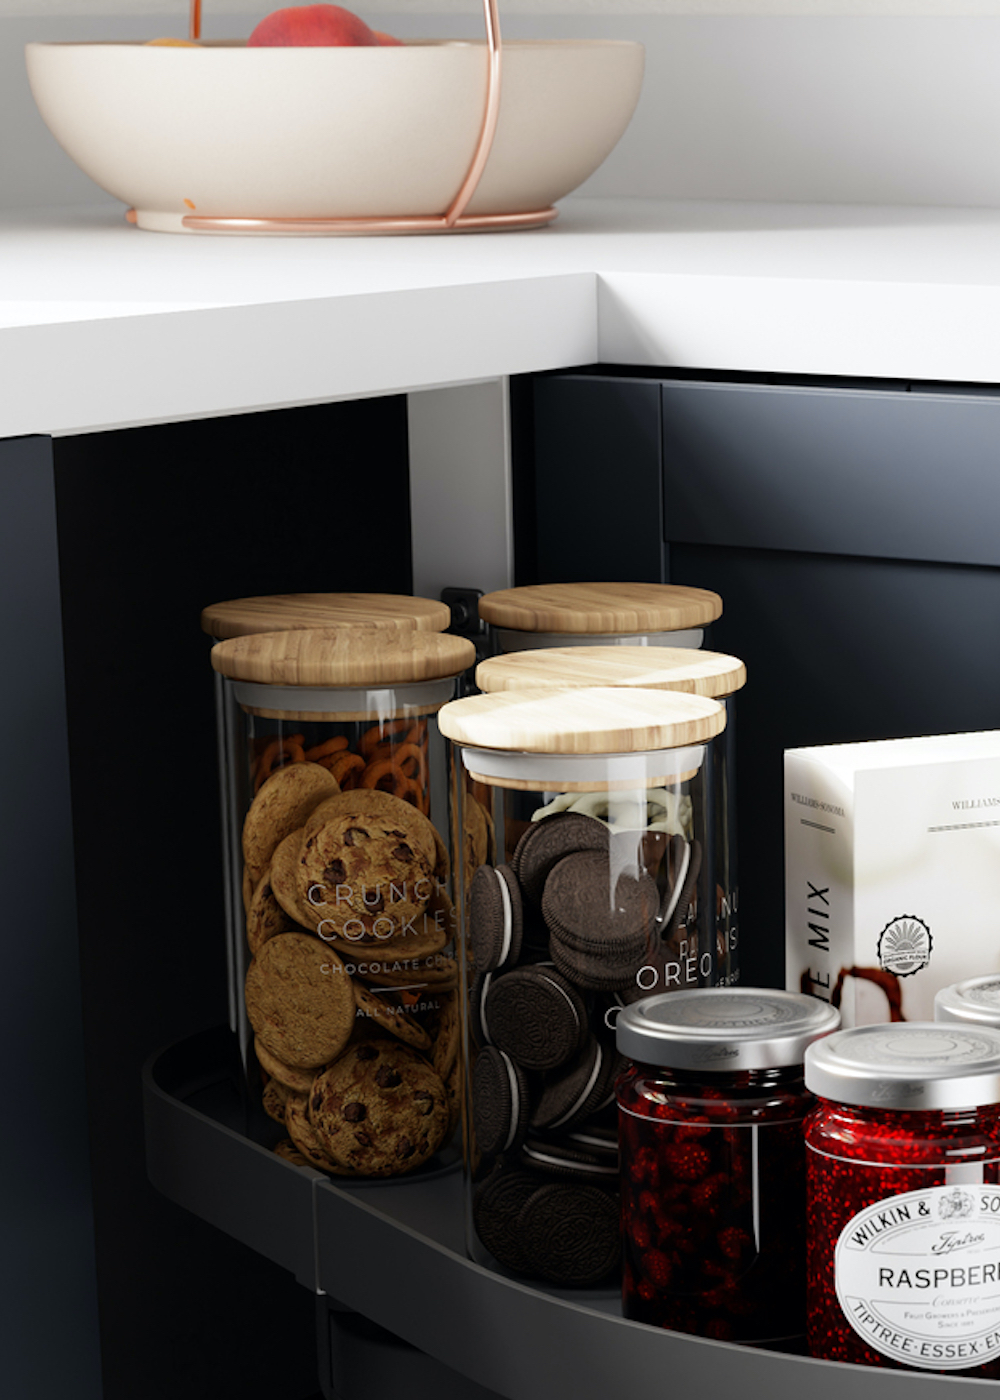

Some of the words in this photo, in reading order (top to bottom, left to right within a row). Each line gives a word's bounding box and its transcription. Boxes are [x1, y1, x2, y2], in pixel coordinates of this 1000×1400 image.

[307, 874, 450, 907] CRUNCH
[806, 880, 830, 952] MIX
[319, 958, 420, 975] CHOCOLATE
[636, 951, 712, 991] OREO
[355, 1007, 381, 1018] ALL
[386, 1000, 441, 1016] NATURAL
[852, 1204, 912, 1246] WILKIN
[918, 1201, 931, 1217] &
[854, 1301, 913, 1353] TIPTREE
[920, 1342, 981, 1358] ESSEX
